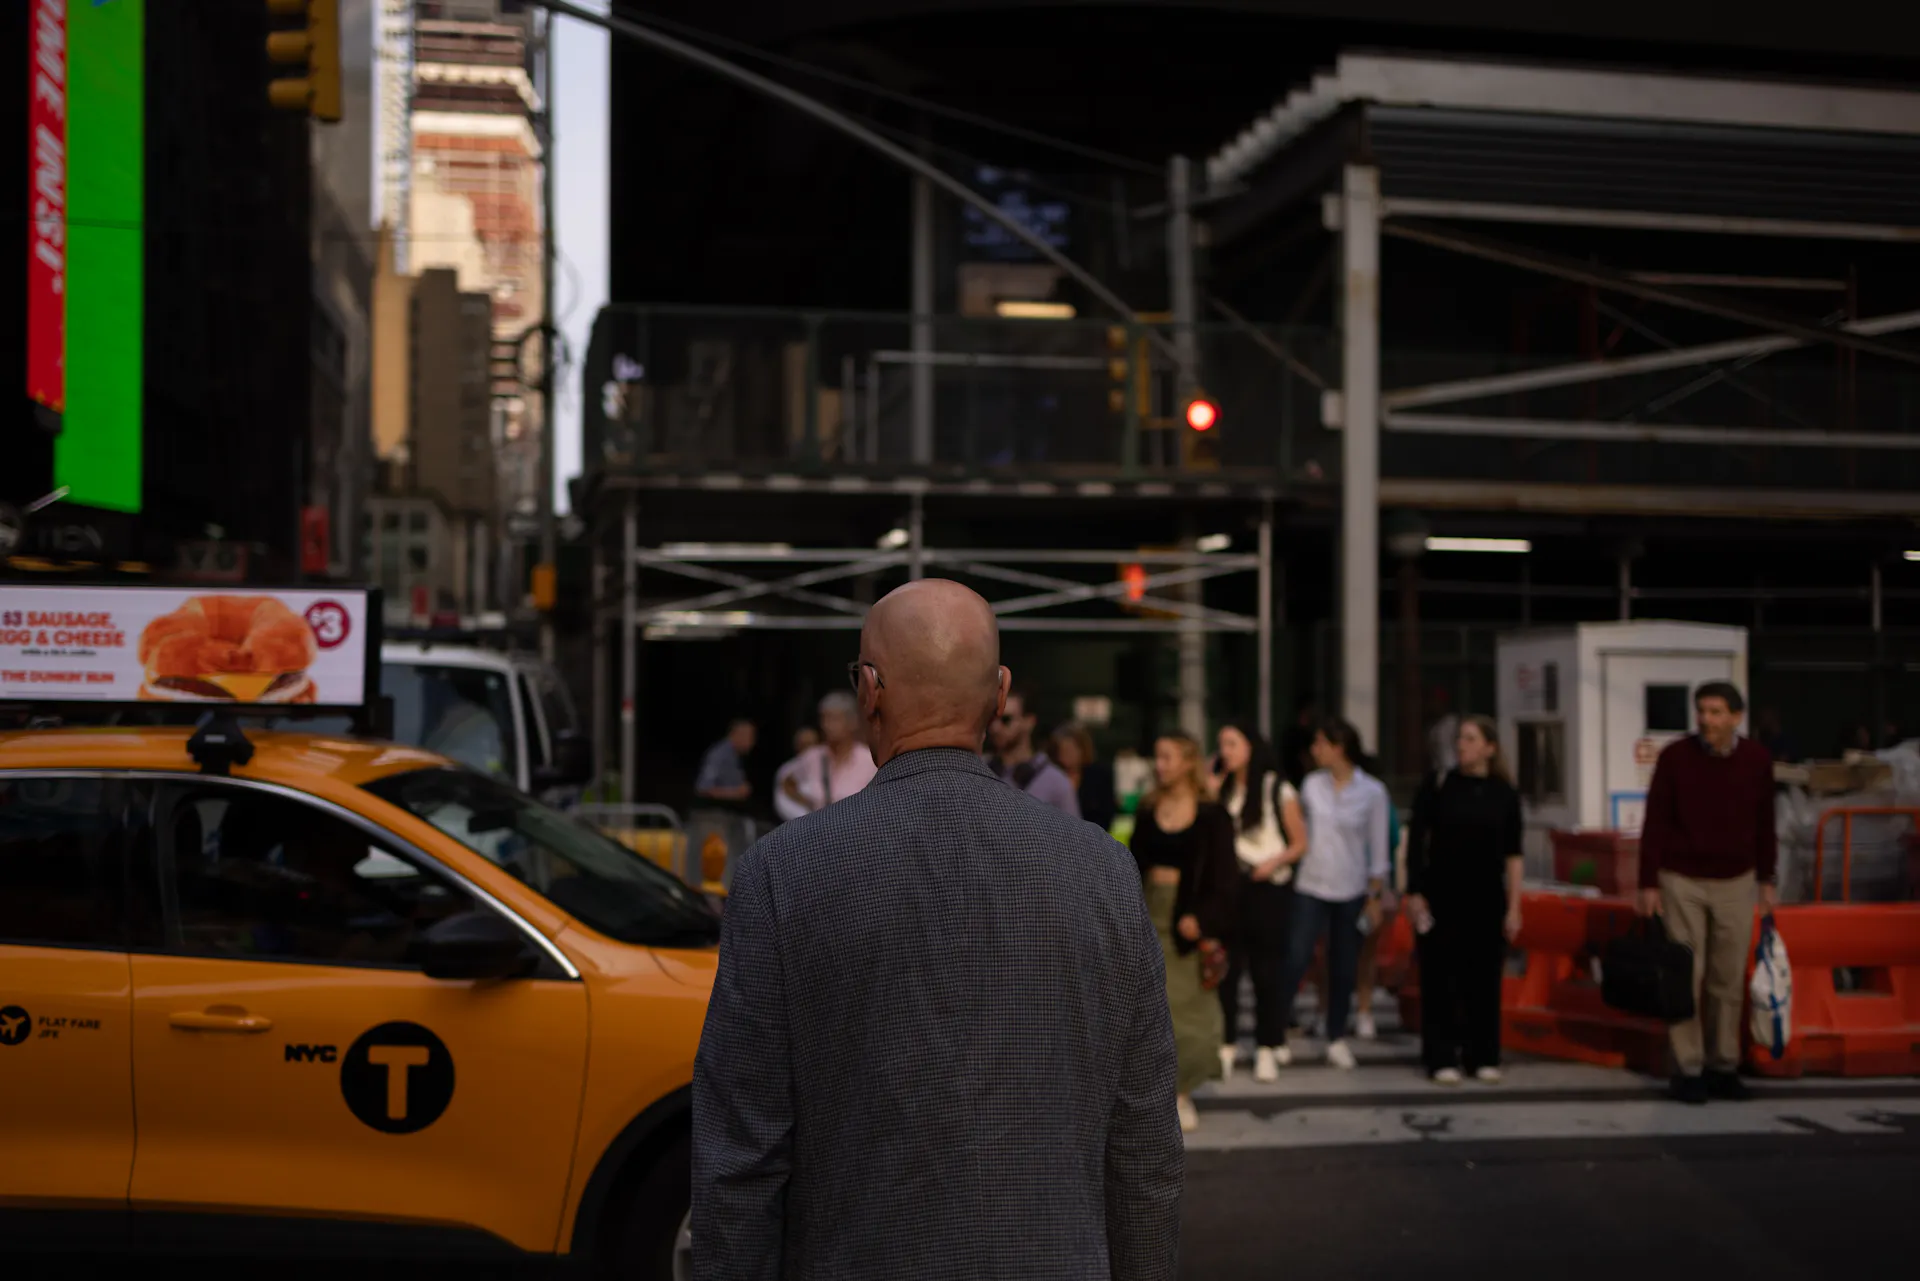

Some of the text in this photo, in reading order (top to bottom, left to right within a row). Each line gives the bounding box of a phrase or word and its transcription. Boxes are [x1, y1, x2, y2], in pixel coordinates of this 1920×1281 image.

[27, 611, 116, 629] SAUSAGE,
[36, 630, 48, 645] &
[53, 630, 125, 647] CHEESE
[39, 1016, 102, 1030] FLAT FARE
[285, 1044, 338, 1062] NYC
[367, 1043, 430, 1121] T
